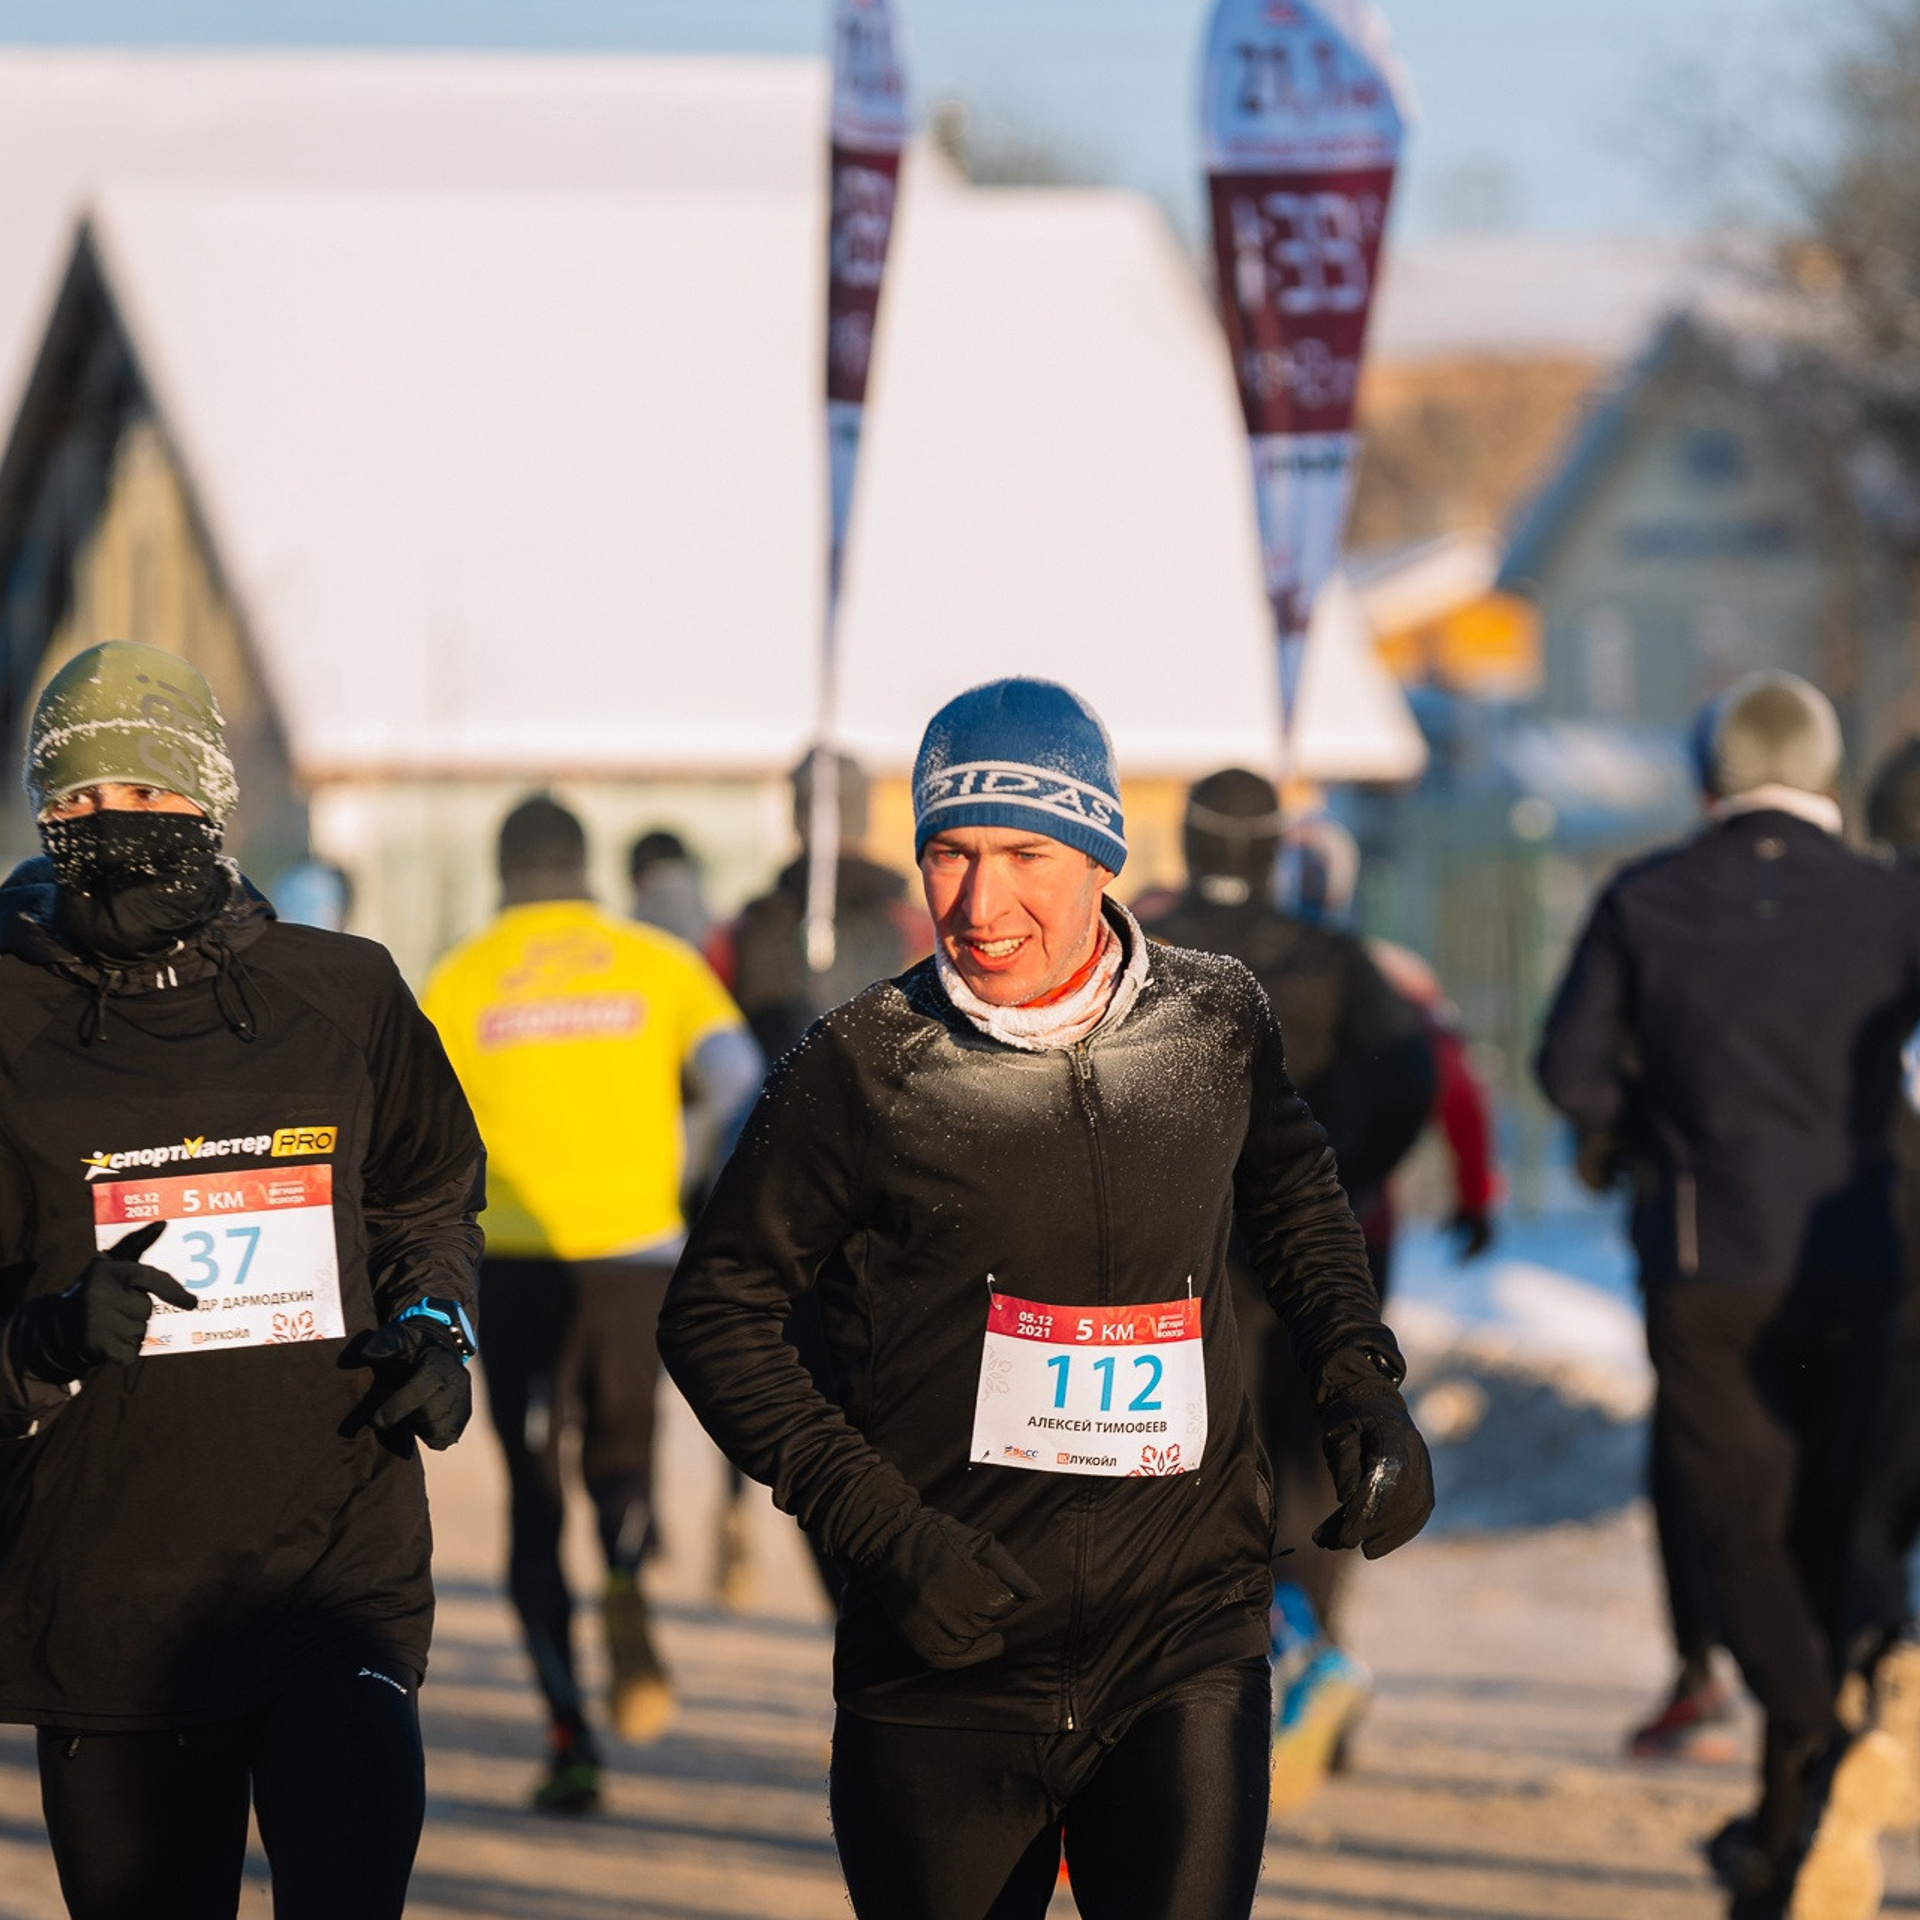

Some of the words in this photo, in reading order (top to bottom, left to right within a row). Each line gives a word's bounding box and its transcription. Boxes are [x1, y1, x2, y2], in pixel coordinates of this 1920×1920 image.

[280, 1132, 333, 1150] PRO
[123, 1192, 161, 1206] 05.12
[182, 1189, 200, 1213] 5
[124, 1206, 160, 1219] 2021
[181, 1226, 261, 1289] 37
[222, 1290, 315, 1312] ДАРМОДЕХИН
[1018, 1311, 1054, 1326] 05.12
[203, 1328, 250, 1342] ЛУКОЙЛ
[1016, 1324, 1051, 1339] 2021
[1075, 1318, 1094, 1341] 5
[1047, 1354, 1163, 1412] 112
[1027, 1415, 1092, 1433] АЛЕКСЕЙ
[1094, 1420, 1168, 1434] ТИМОФЕЕВ
[1069, 1454, 1117, 1468] ЛУКОЙЛ
